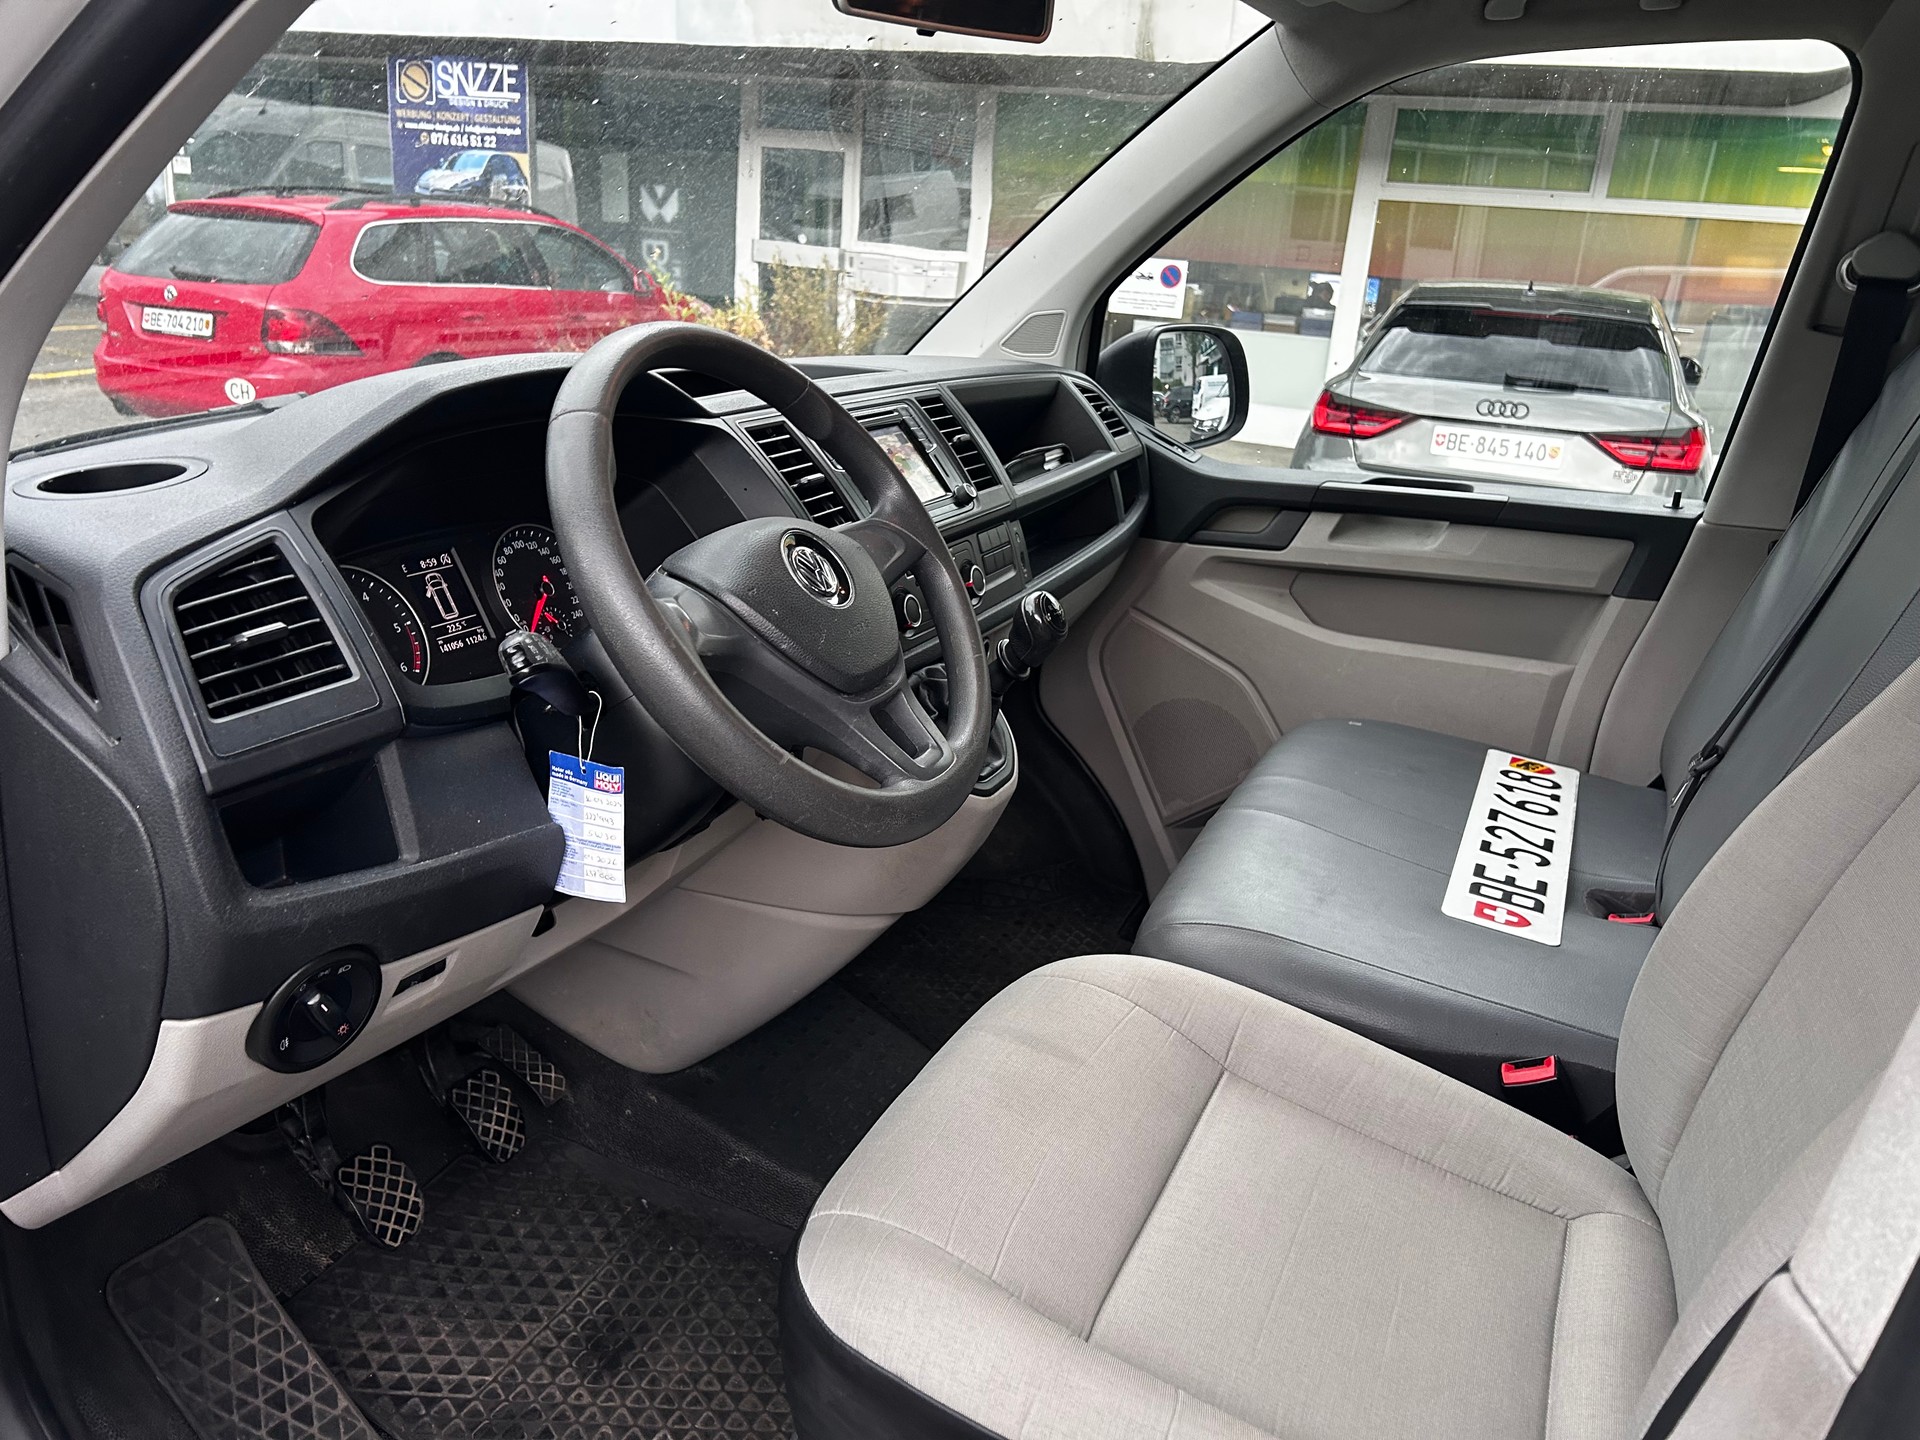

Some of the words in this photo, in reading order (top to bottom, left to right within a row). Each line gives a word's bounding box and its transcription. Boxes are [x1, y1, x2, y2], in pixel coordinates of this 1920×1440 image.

[437, 60, 520, 97] SKIZZE
[436, 111, 470, 122] KONZEPT
[474, 113, 521, 124] GESTALTUNG
[431, 132, 449, 146] 076
[450, 133, 468, 147] 616
[483, 135, 496, 148] 22
[230, 383, 251, 400] CH
[512, 540, 525, 549] 100
[525, 541, 538, 550] 120
[503, 546, 514, 556] 80
[538, 547, 550, 556] 140
[401, 564, 408, 573] E
[420, 557, 437, 569] 8:59
[497, 556, 507, 565] 60
[549, 555, 562, 565] 160
[362, 592, 370, 602] 4
[570, 609, 584, 619] 240
[393, 622, 401, 633] 5
[439, 640, 464, 653] 141056
[466, 633, 488, 646] 1124.6
[400, 662, 408, 673] 6
[595, 771, 620, 783] LIQUI
[595, 780, 621, 792] MOLY
